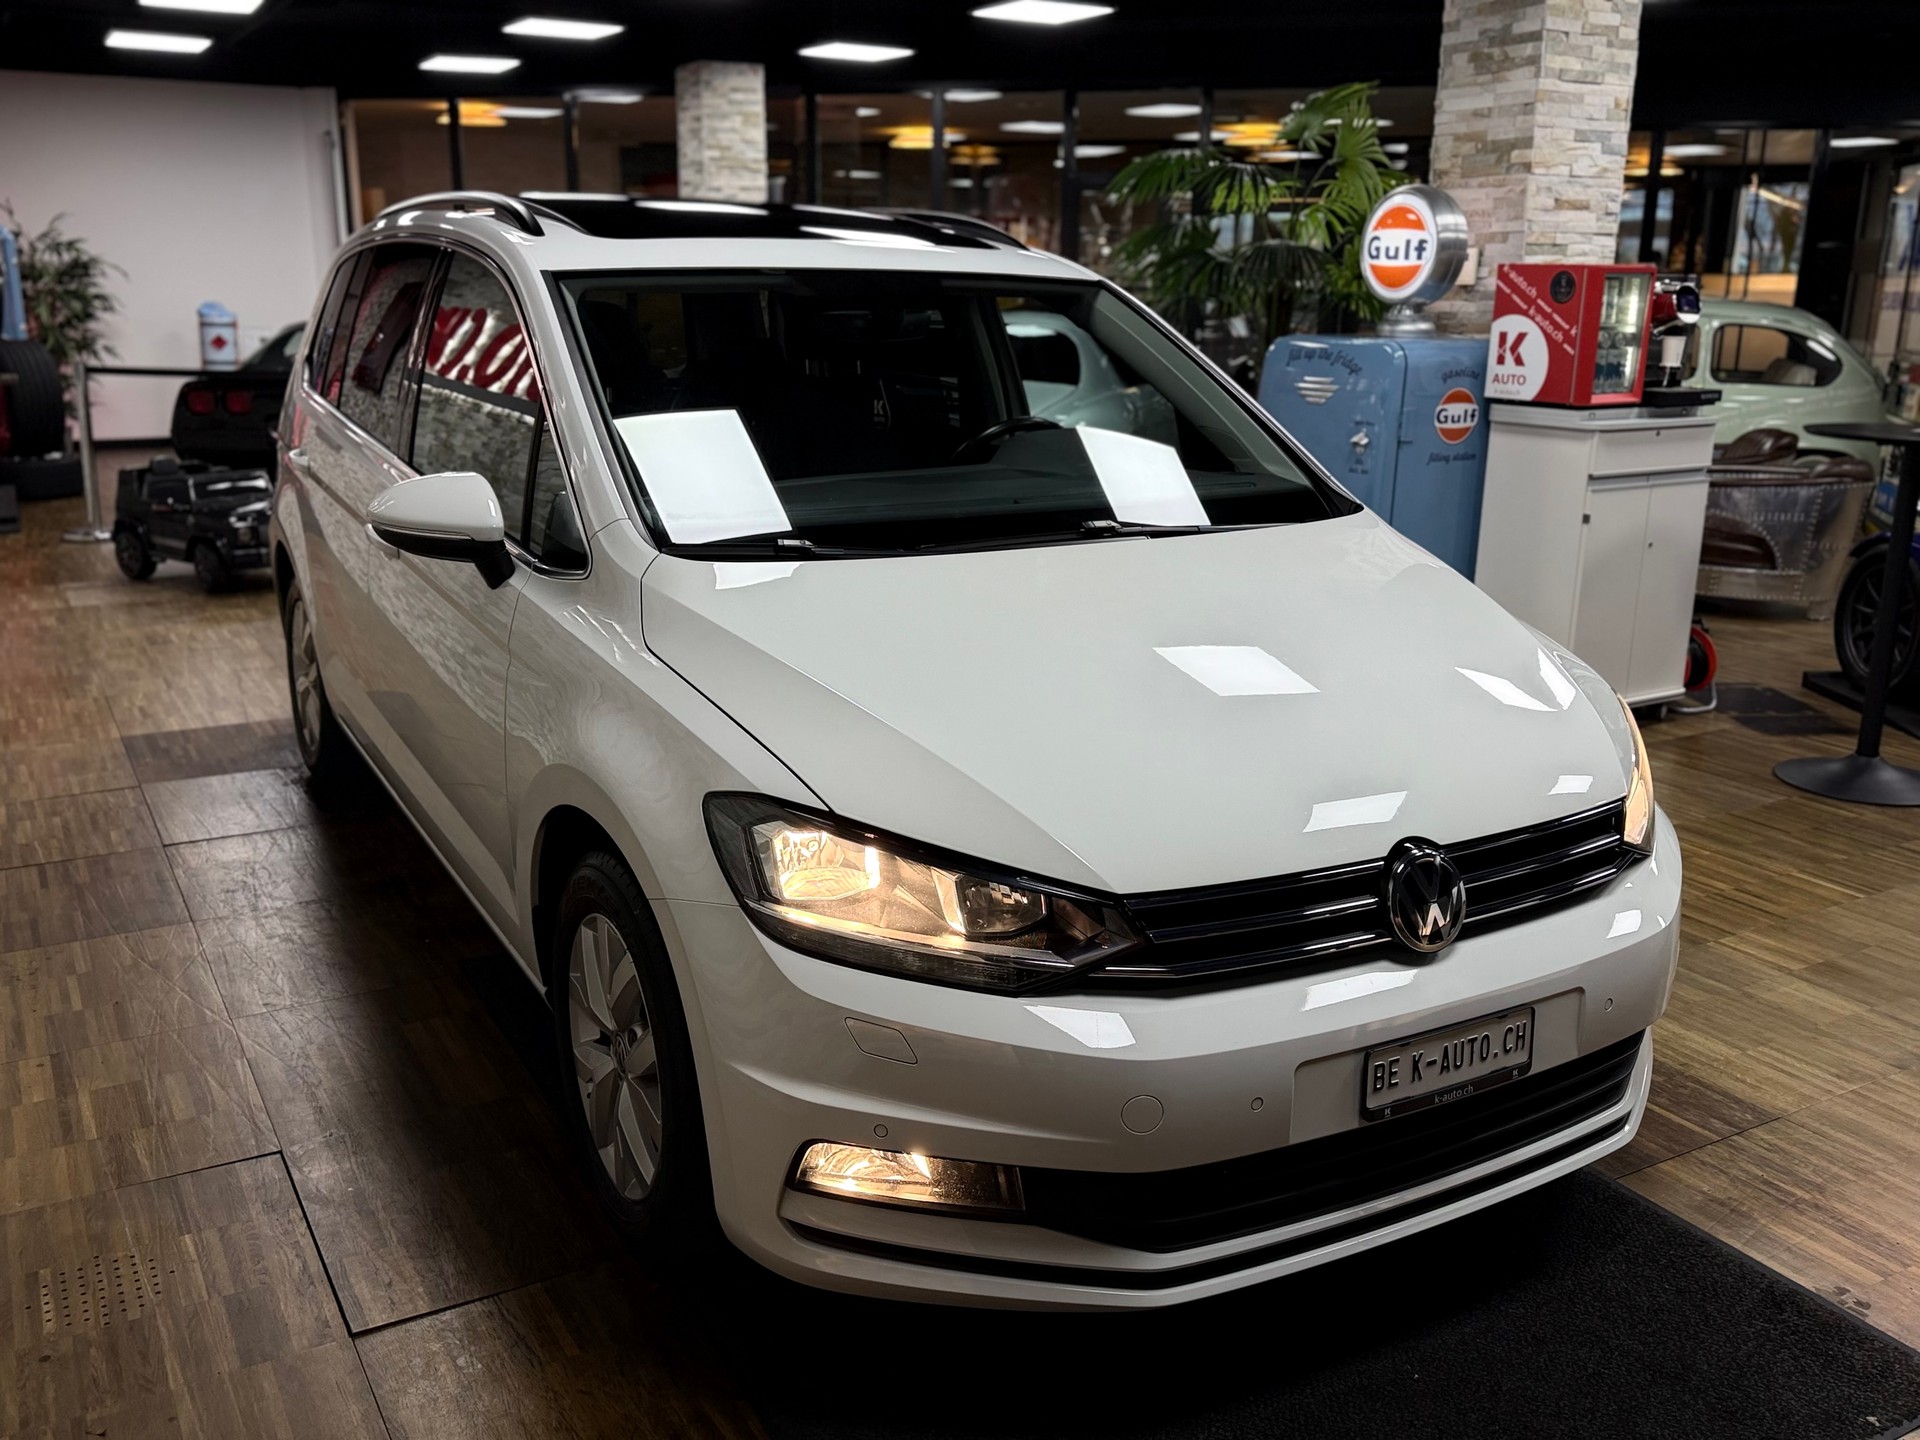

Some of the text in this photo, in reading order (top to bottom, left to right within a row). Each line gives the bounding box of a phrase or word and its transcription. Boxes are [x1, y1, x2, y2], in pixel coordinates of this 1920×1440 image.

[1368, 236, 1428, 261] Gulf
[1496, 331, 1528, 366] K
[1492, 373, 1527, 386] AUTO
[1436, 408, 1478, 424] Gulf
[1373, 1021, 1527, 1092] BE K-AUTO.CH
[1434, 1084, 1474, 1104] k-auto.ch
